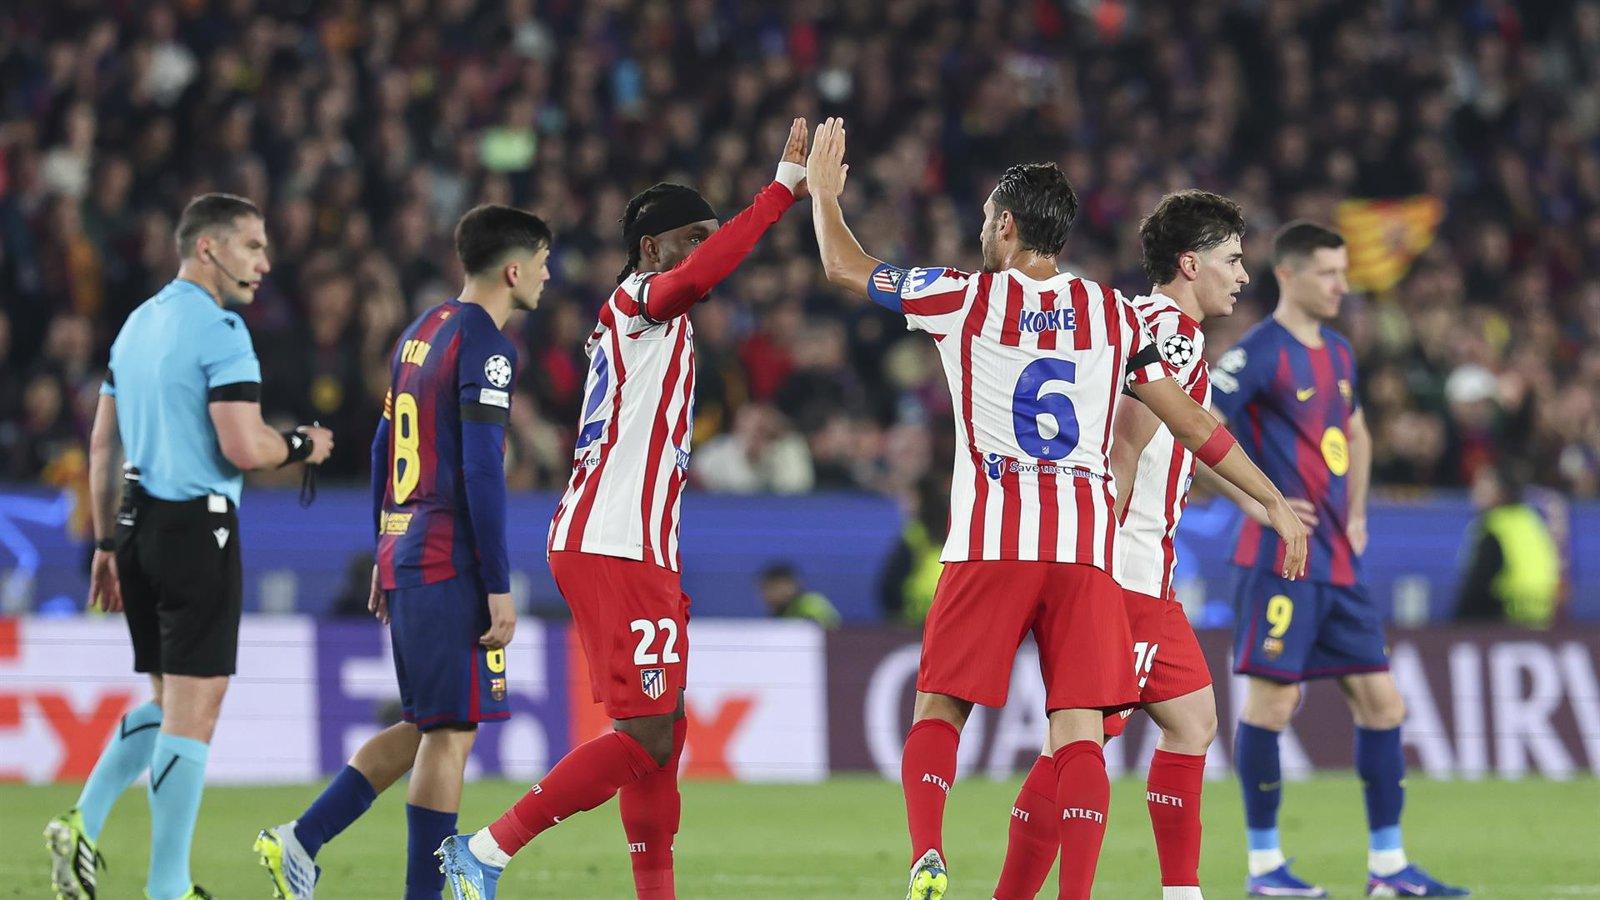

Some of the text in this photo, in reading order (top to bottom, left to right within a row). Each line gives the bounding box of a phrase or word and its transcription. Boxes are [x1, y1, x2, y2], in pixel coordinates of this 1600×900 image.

[1019, 308, 1076, 333] KOKE
[1012, 357, 1080, 461] 6
[393, 392, 421, 505] 8
[1010, 461, 1039, 473] Save
[1040, 464, 1061, 474] the
[1266, 594, 1294, 639] 9
[630, 617, 681, 666] 22
[1062, 807, 1103, 824] ATLETI
[1146, 790, 1183, 808] ATLETI
